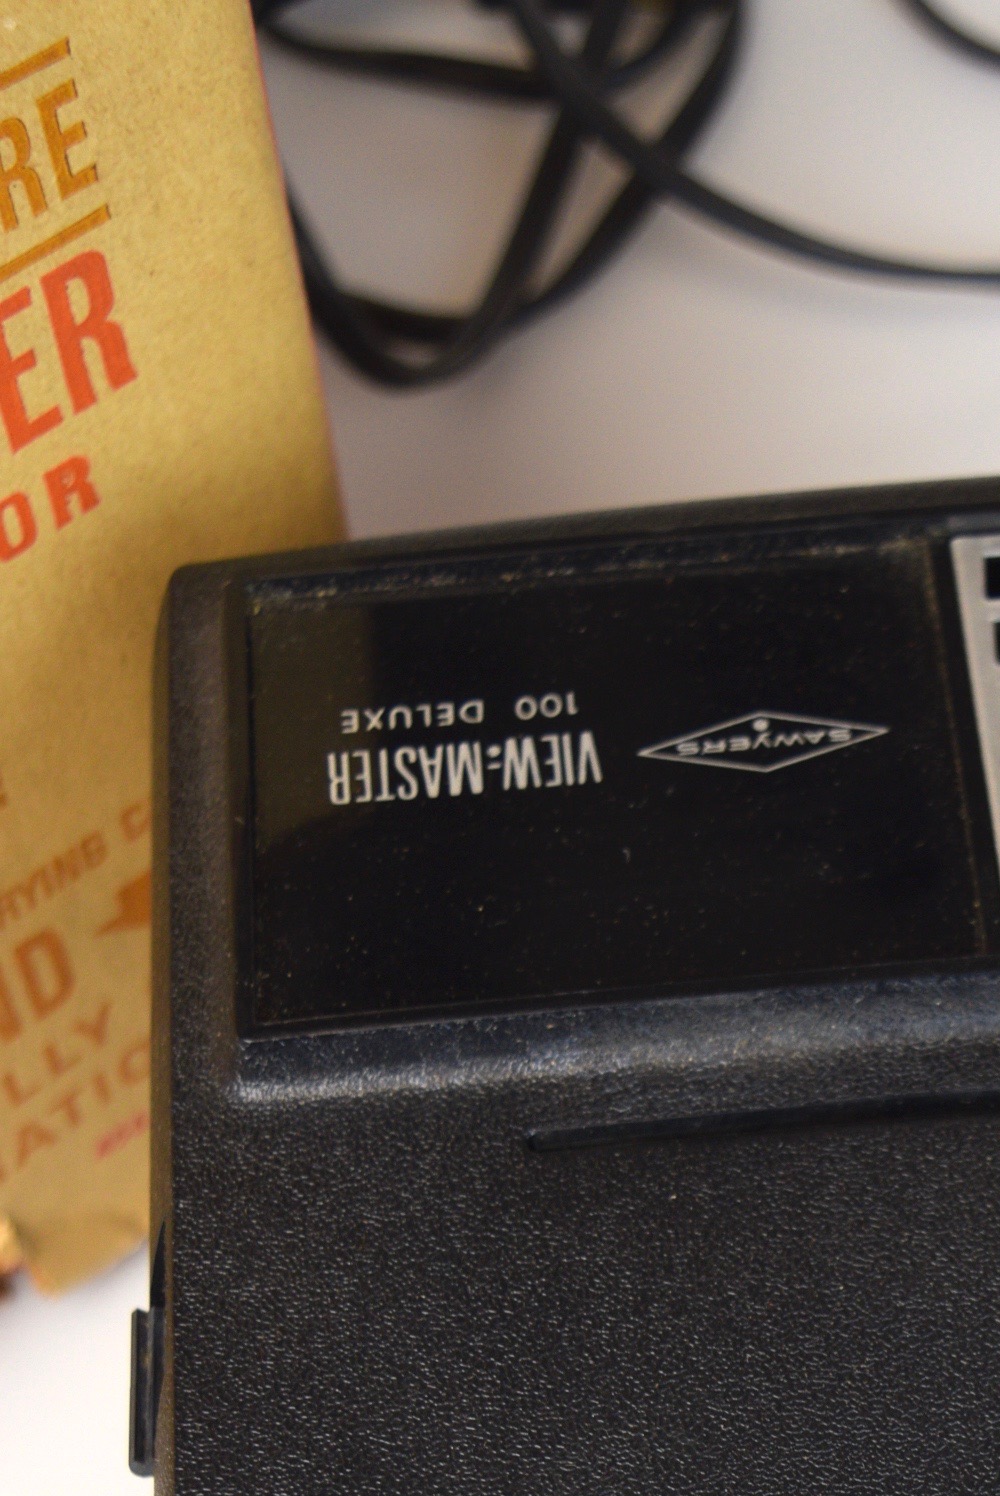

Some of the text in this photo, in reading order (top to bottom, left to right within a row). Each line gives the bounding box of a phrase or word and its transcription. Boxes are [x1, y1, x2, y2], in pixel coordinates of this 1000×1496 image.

[0, 78, 99, 232] RE
[0, 249, 138, 455] ER
[0, 455, 101, 562] OR
[340, 691, 579, 734] 100 DELUXE
